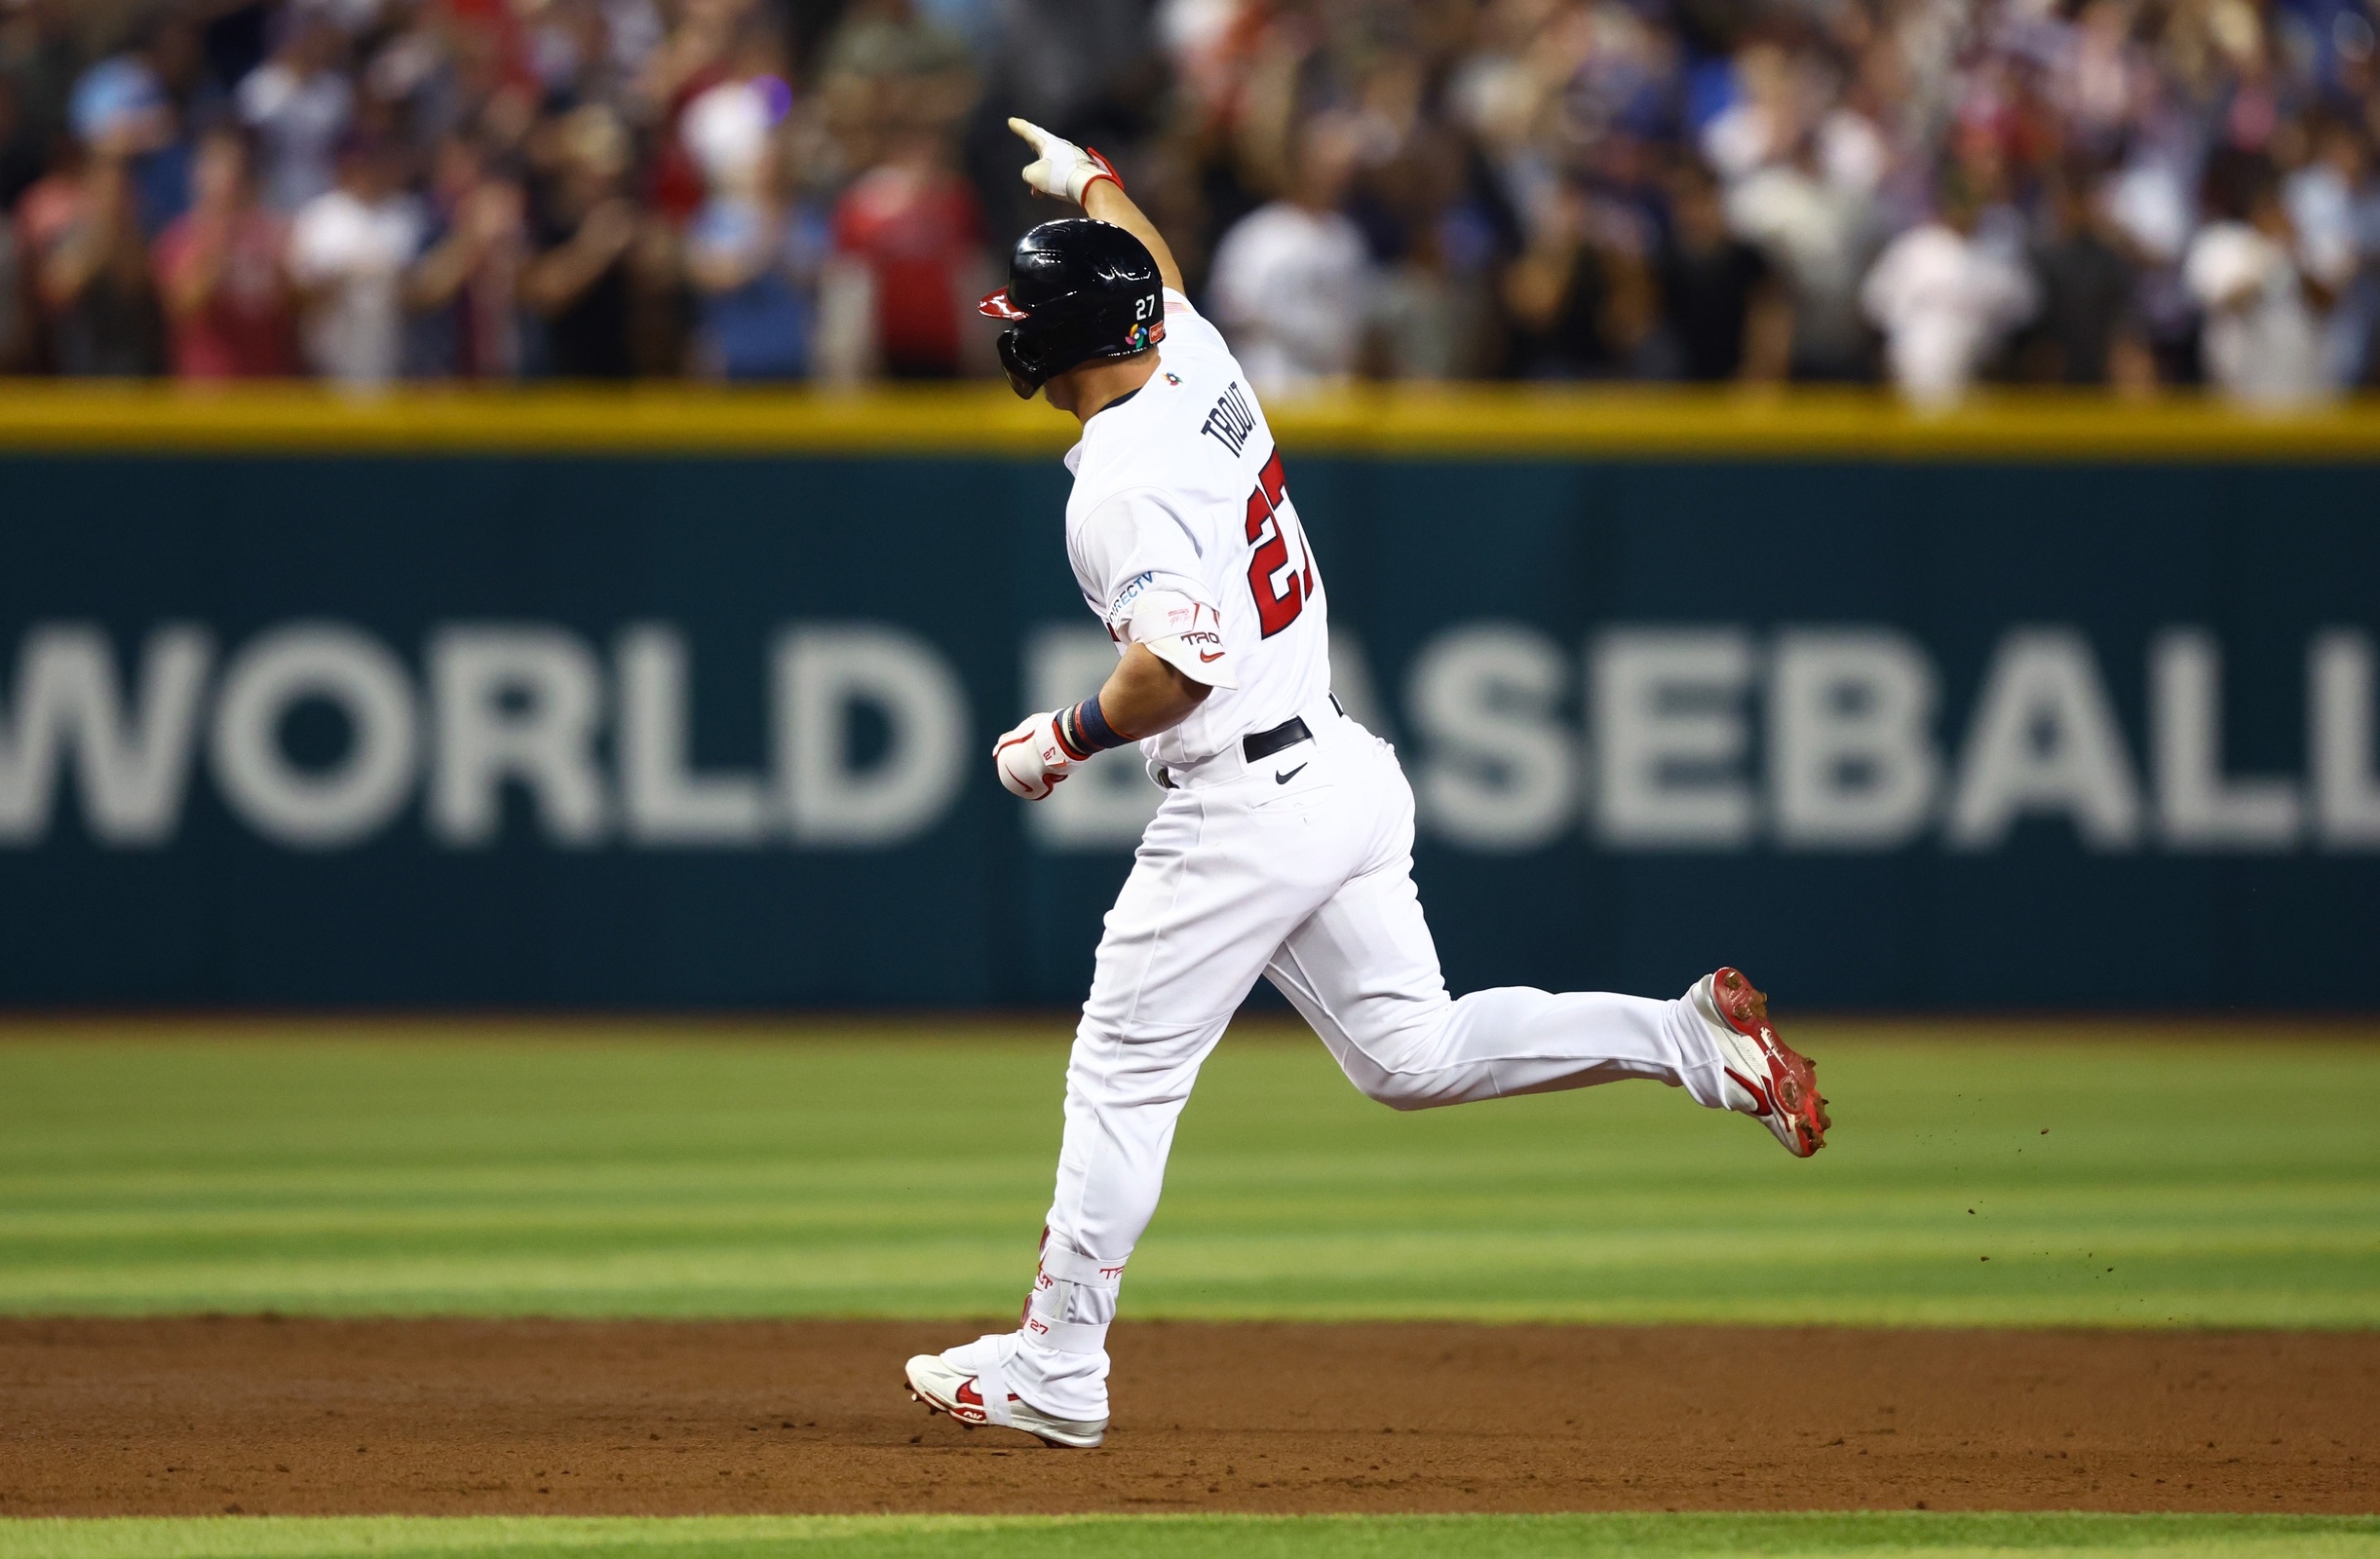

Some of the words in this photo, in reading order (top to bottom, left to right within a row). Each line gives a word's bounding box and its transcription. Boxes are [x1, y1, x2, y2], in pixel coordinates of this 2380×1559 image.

[1134, 293, 1156, 321] 27
[1200, 380, 1257, 459] TROUT
[1245, 443, 1315, 641] 27
[0, 624, 970, 846] WORLD
[1042, 745, 1056, 761] 27
[1029, 1317, 1050, 1336] 27
